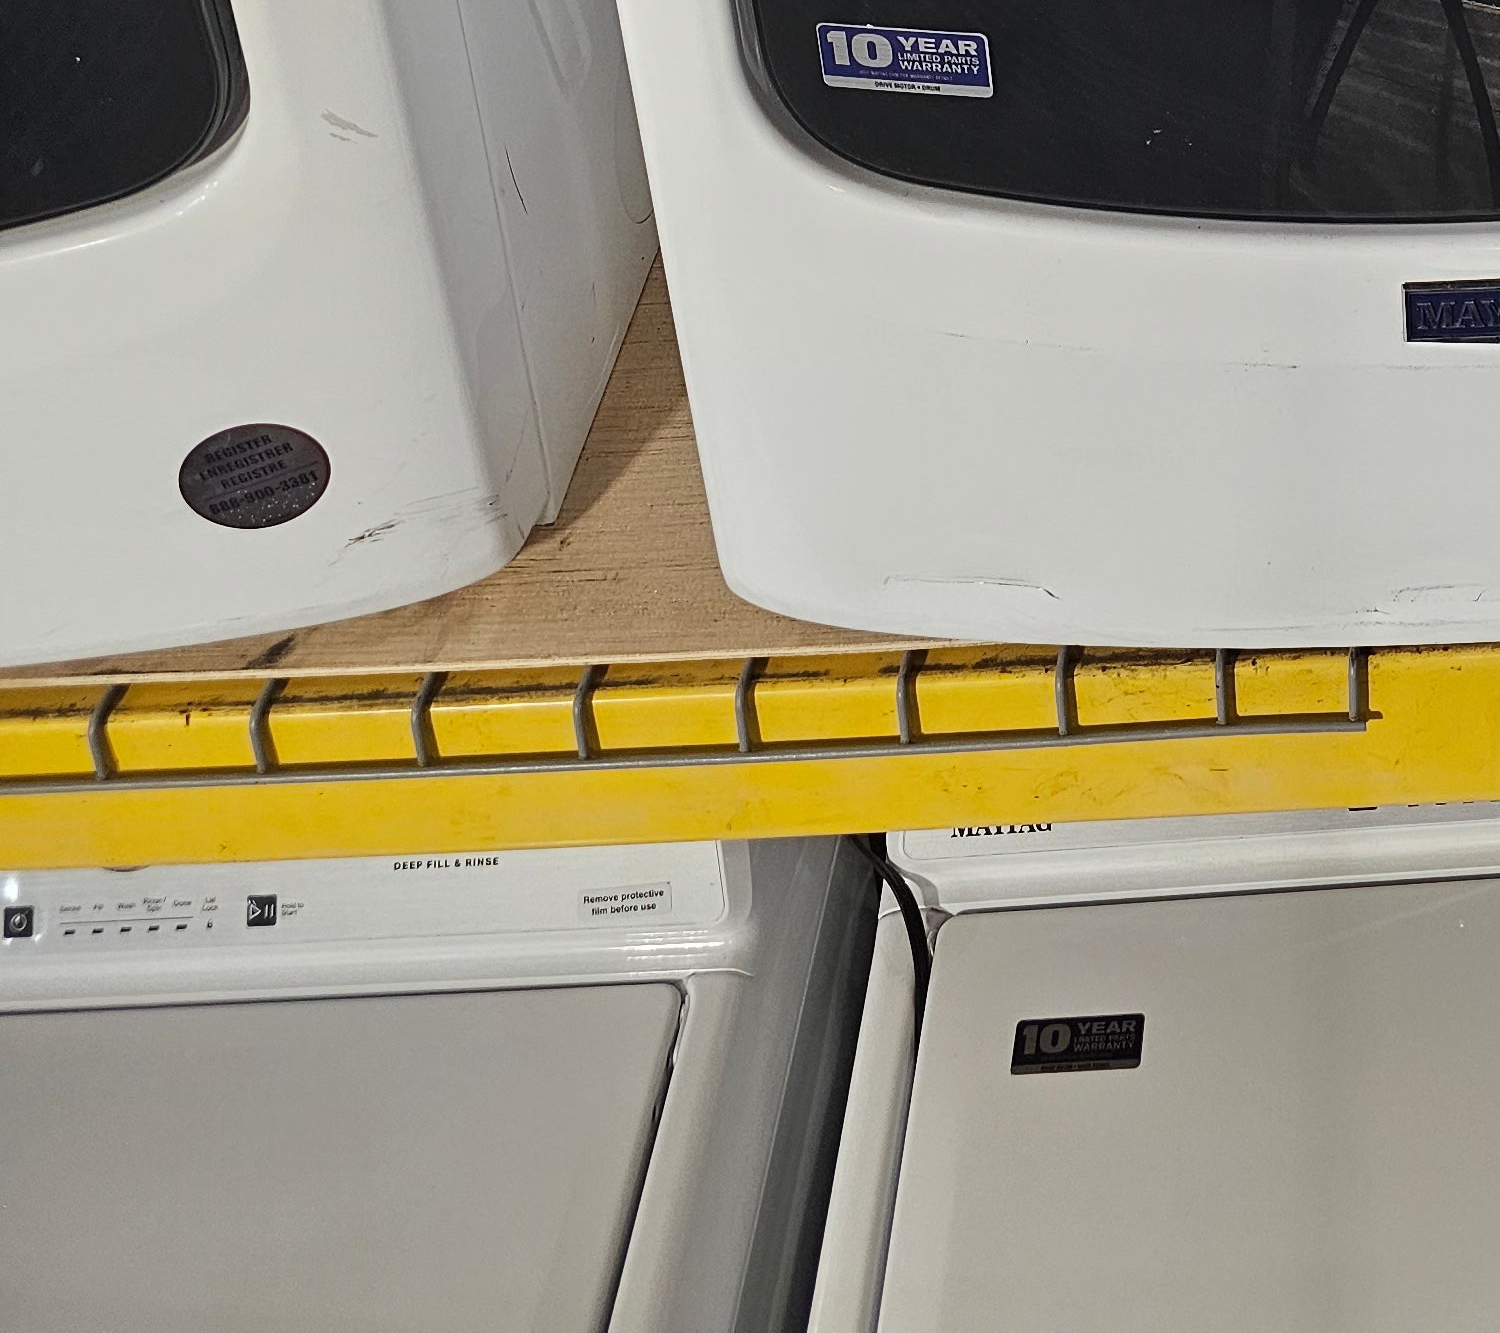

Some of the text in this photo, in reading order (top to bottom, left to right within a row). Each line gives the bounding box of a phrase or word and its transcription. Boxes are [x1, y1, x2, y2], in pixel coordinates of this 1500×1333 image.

[826, 30, 978, 68] 10 YEAR
[897, 52, 980, 65] LIMITED PARTS
[898, 60, 980, 75] WARRANTY
[204, 434, 273, 465] REGISTER
[221, 459, 289, 490] REGISTRE
[393, 857, 499, 871] DEEP FILL & RINSE
[583, 889, 664, 904] Remove protective
[591, 902, 657, 915] film before use
[1023, 1020, 1136, 1055] 10 YEAR
[1073, 1041, 1135, 1053] WARRANTY
